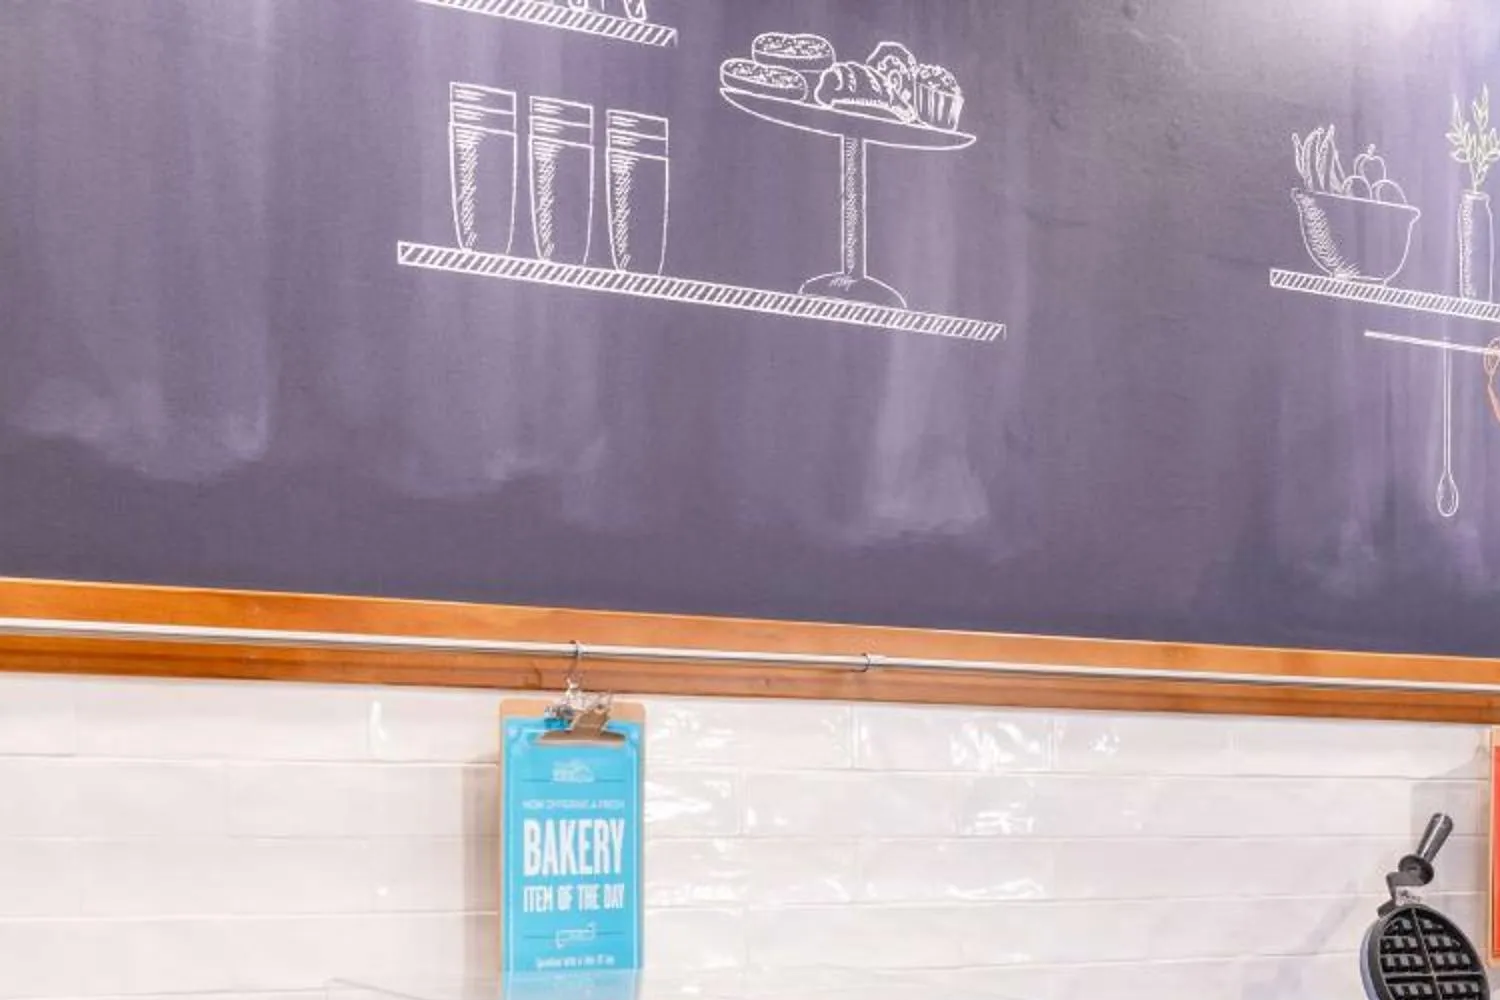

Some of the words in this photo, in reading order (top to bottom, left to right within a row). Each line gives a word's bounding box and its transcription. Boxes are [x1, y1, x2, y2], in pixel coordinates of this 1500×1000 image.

[523, 818, 626, 877] BAKERY
[523, 885, 552, 913] ITEM
[556, 885, 574, 911] OF
[577, 884, 600, 911] THE
[603, 883, 625, 909] DAY
